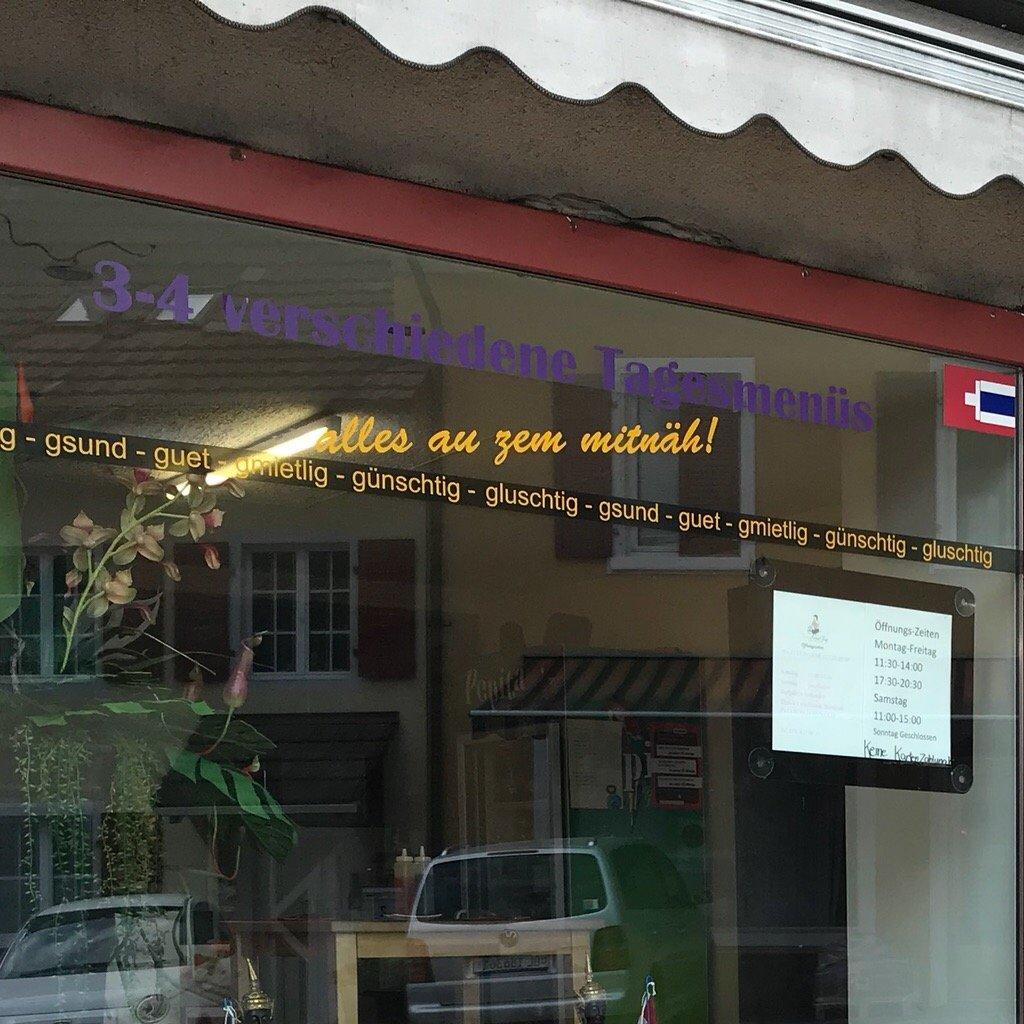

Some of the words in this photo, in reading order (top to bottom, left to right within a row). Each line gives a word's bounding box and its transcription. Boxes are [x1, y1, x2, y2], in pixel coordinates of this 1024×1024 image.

[92, 260, 194, 324] 3-4
[222, 292, 578, 383] verschiedene
[594, 345, 874, 432] Tagesmenüs
[316, 414, 413, 454] alles
[428, 428, 480, 454] au
[494, 427, 567, 466] zem
[580, 415, 719, 454] mitnäh!
[45, 432, 127, 460] gsund
[154, 446, 210, 469] guet
[236, 456, 328, 488] gmietlig
[352, 467, 460, 503] günschtig
[486, 483, 578, 517] gluschtig
[599, 500, 659, 523] gsund
[679, 510, 721, 531] guet
[738, 518, 808, 546] gmietlig
[826, 527, 906, 558] günschtig
[923, 540, 993, 569] gluschtig
[875, 619, 940, 639] Öffnungs-Zeiten
[874, 639, 937, 658] Montag-Freitag
[874, 658, 923, 672] 11:30-14:00
[874, 675, 923, 690] 17:30-20:30
[874, 693, 908, 708] Samstag
[873, 711, 922, 725] 11:00-15:00
[873, 728, 899, 739] Sonntag
